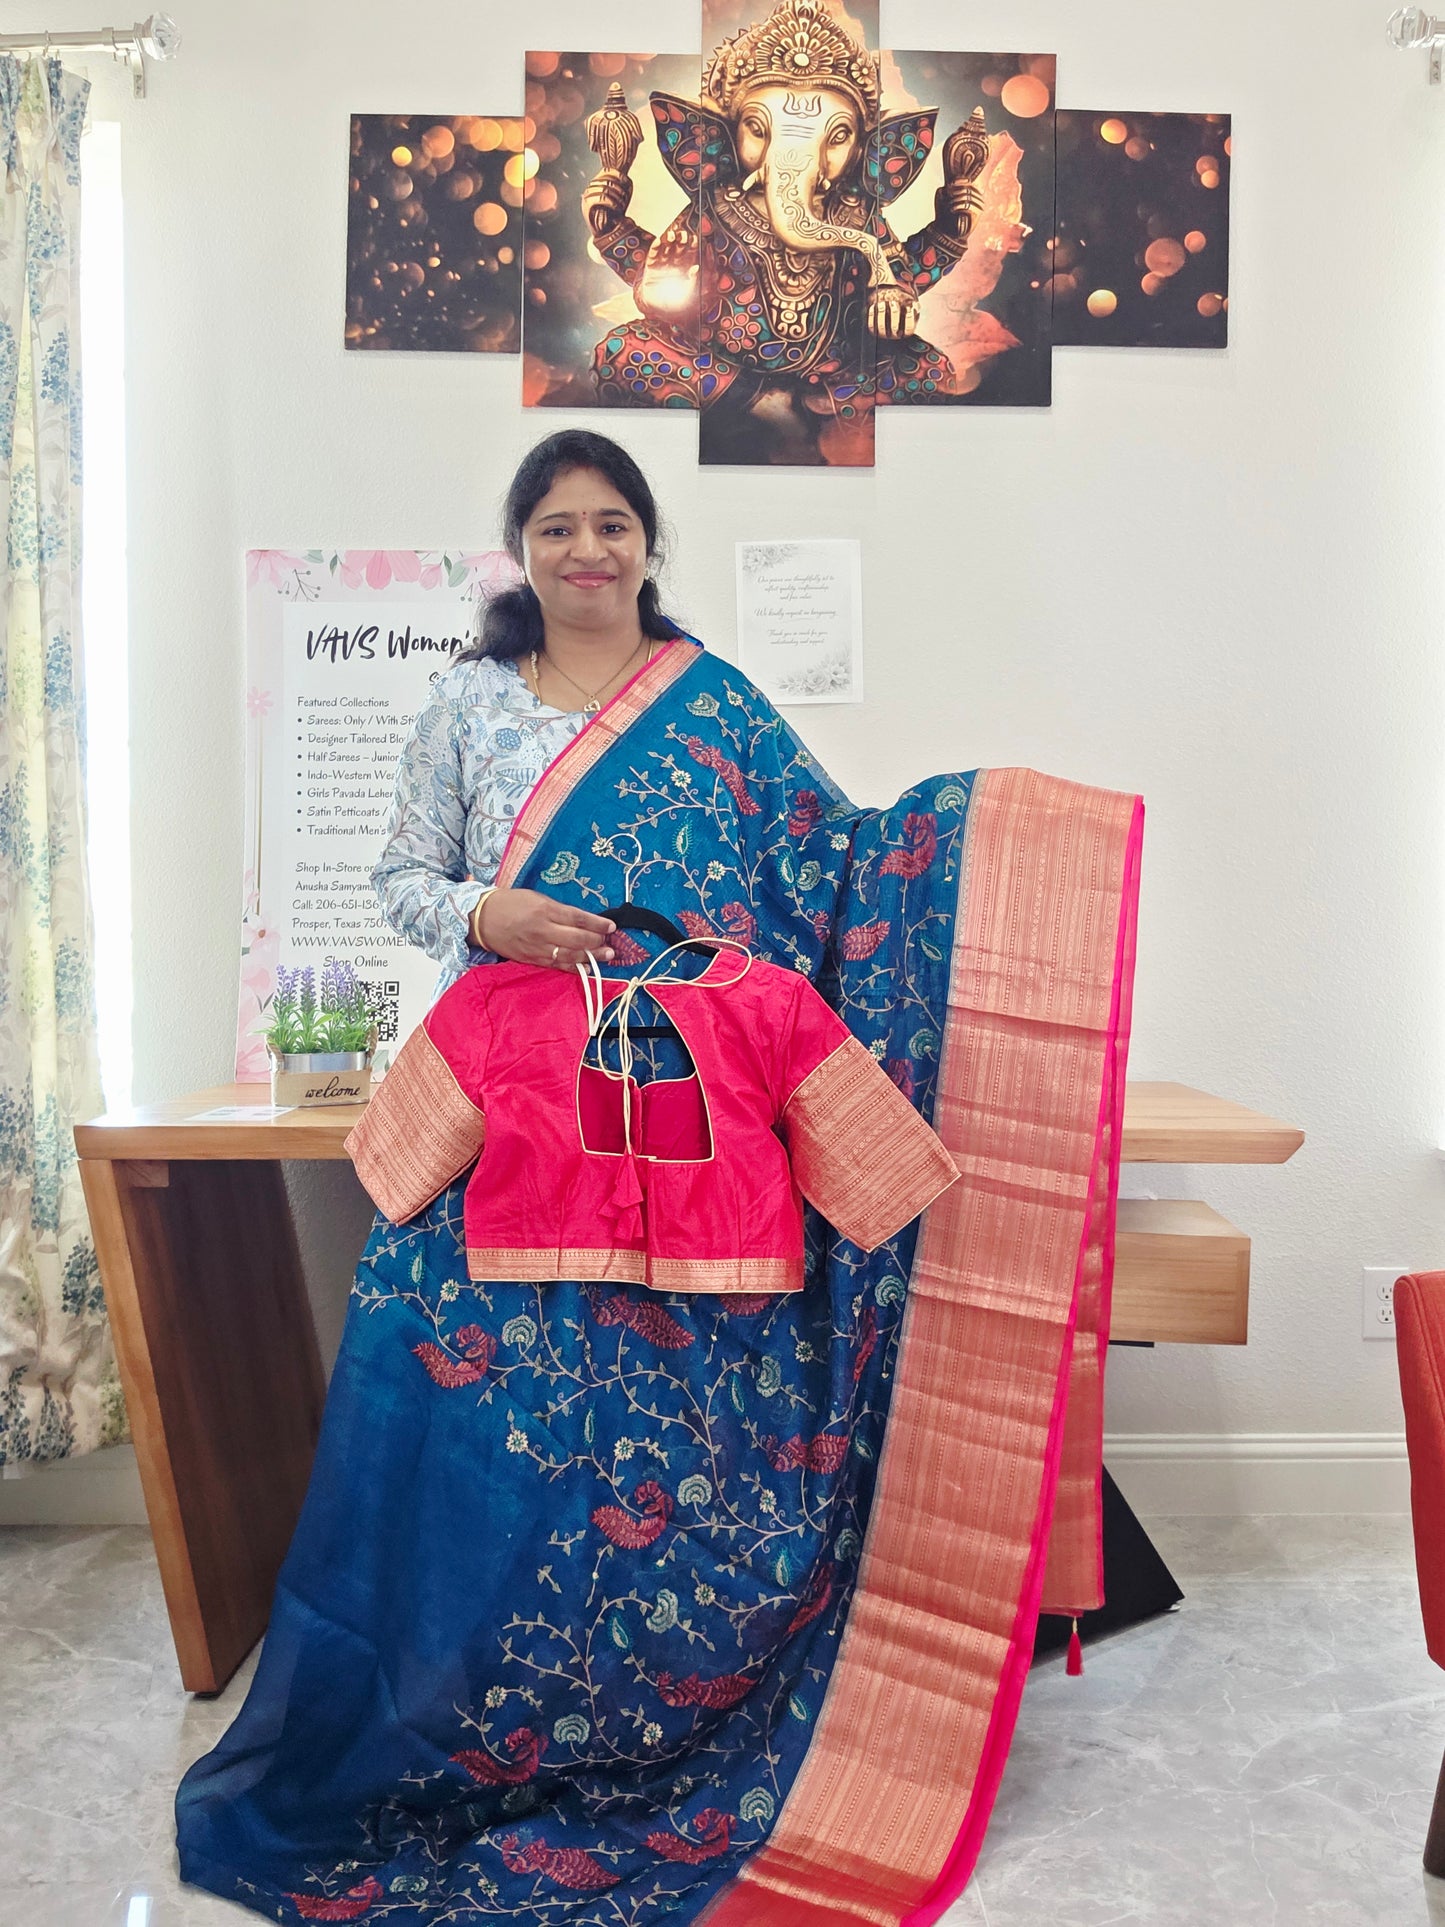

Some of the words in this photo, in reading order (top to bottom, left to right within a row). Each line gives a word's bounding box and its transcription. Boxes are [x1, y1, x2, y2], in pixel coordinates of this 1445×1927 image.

[306, 624, 380, 664] VAVS
[297, 696, 338, 707] Featured
[339, 696, 390, 707] Collections
[307, 714, 342, 725] Sarees:
[343, 714, 366, 729] Only
[375, 715, 399, 725] With
[400, 715, 415, 725] Sti
[307, 733, 348, 747] Designer
[349, 733, 387, 743] Tailored
[389, 732, 407, 743] Blo
[308, 751, 327, 762] Half
[328, 751, 361, 762] Sarees
[307, 769, 372, 780] Indo-Western
[307, 787, 330, 798] Girls
[332, 787, 366, 798] Pavada
[307, 806, 331, 816] Satin
[334, 806, 380, 816] Petticoats
[307, 824, 356, 835] Traditional
[358, 824, 387, 835] Men's
[295, 862, 320, 876] Shop
[323, 862, 362, 872] In-Store
[295, 881, 329, 891] Anusha
[330, 880, 374, 895] Samyam
[292, 899, 314, 909] Call:
[316, 899, 380, 910] 206-651-136
[292, 917, 331, 932] Prosper,
[333, 917, 361, 928] Texas
[354, 955, 389, 967] Online
[305, 1076, 361, 1098] welcome
